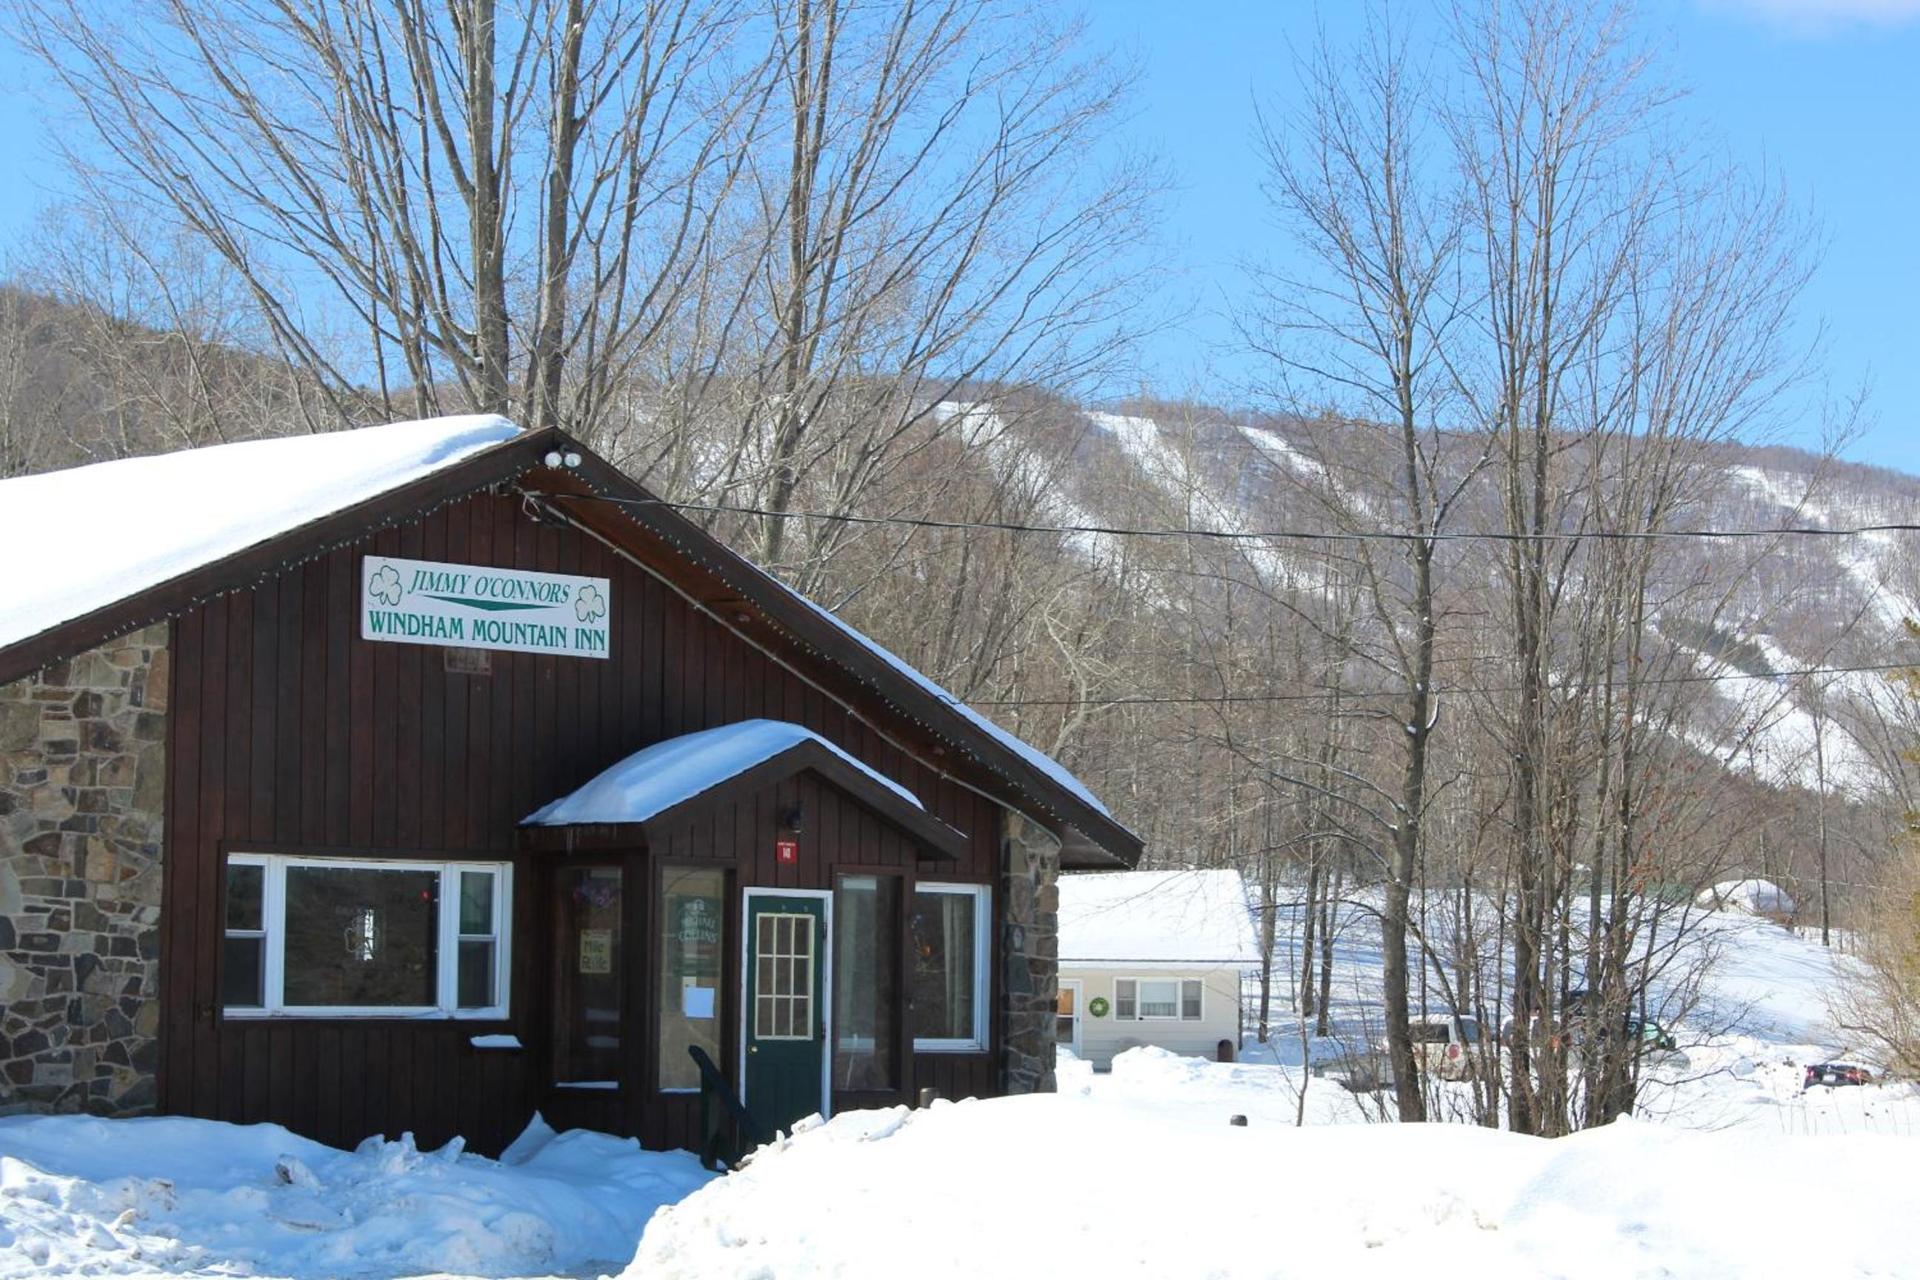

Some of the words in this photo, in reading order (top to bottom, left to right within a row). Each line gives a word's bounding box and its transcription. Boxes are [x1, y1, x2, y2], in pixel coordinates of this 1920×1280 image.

[407, 569, 471, 595] JIMMY
[474, 576, 571, 604] O'CONNORS
[368, 610, 464, 640] WINDHAM
[472, 619, 567, 648] MOUNTAIN
[574, 628, 605, 651] INN
